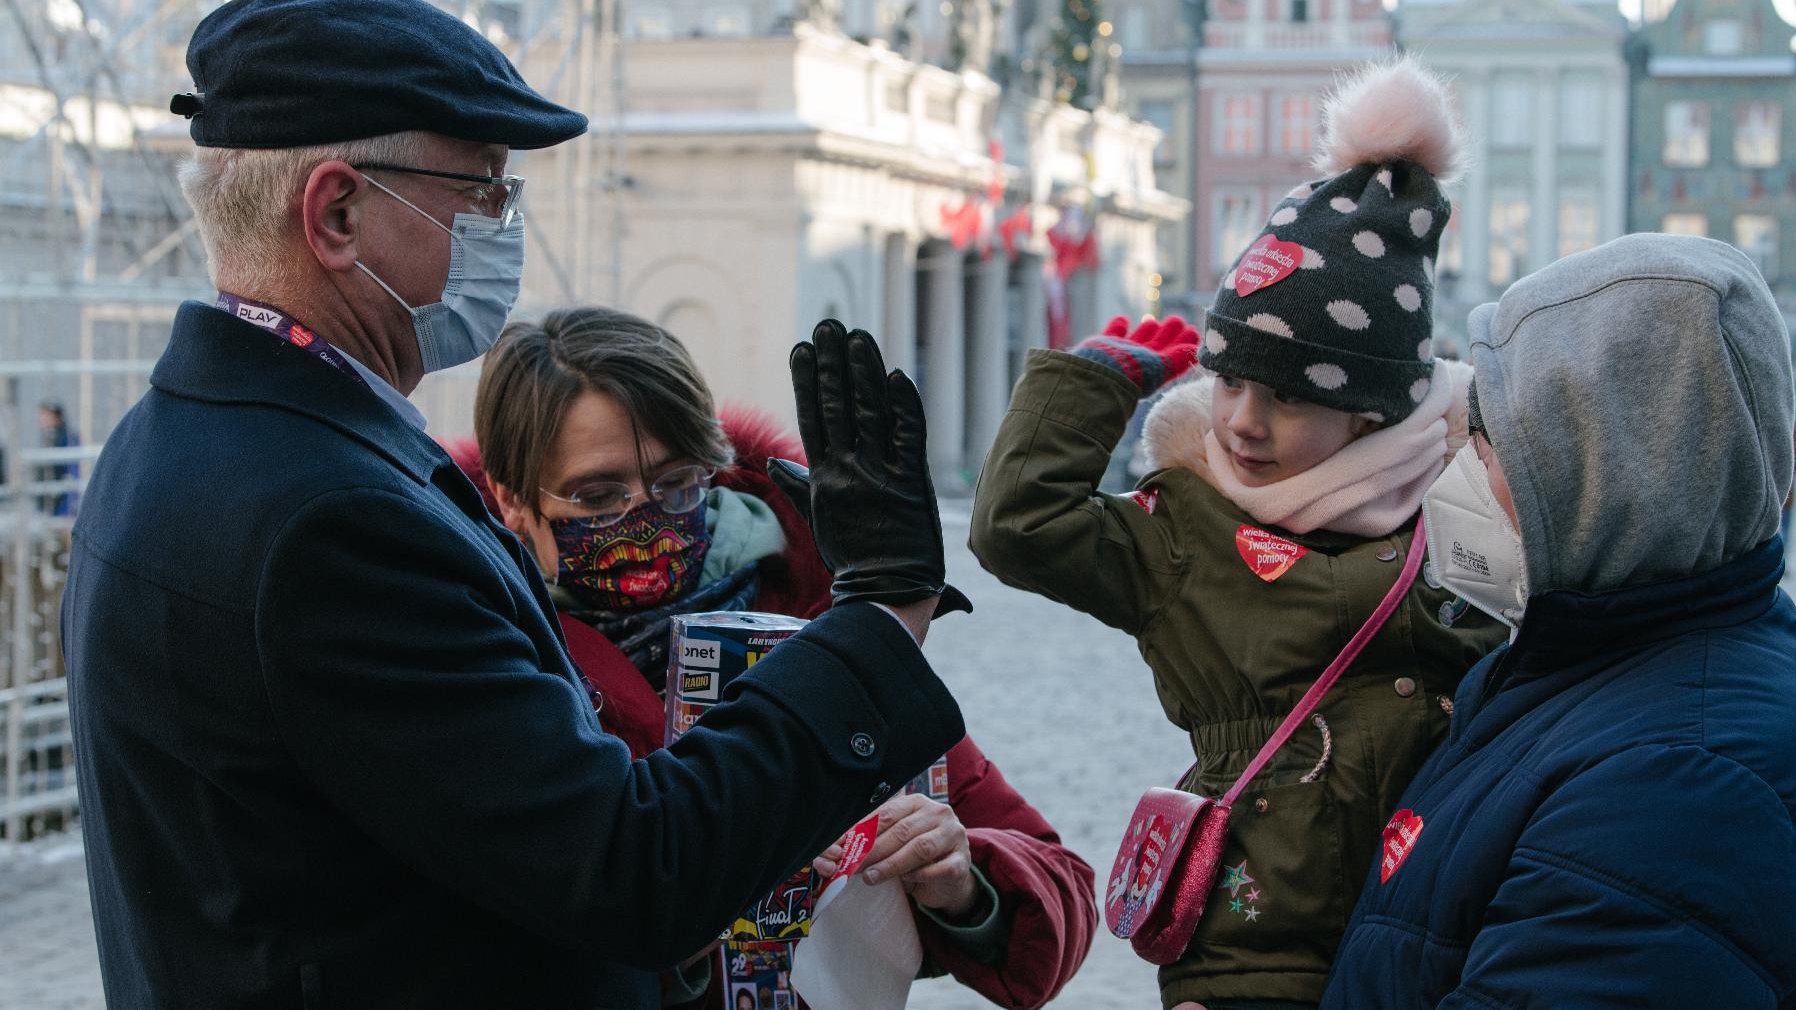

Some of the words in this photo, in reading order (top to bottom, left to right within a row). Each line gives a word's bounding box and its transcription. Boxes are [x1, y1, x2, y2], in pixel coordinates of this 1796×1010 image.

[1238, 272, 1265, 288] pomocy
[240, 307, 277, 323] PLAY
[1242, 528, 1270, 539] wielka
[1248, 538, 1298, 556] świątecznej
[1257, 553, 1290, 569] pomocy
[684, 675, 710, 689] RADIO
